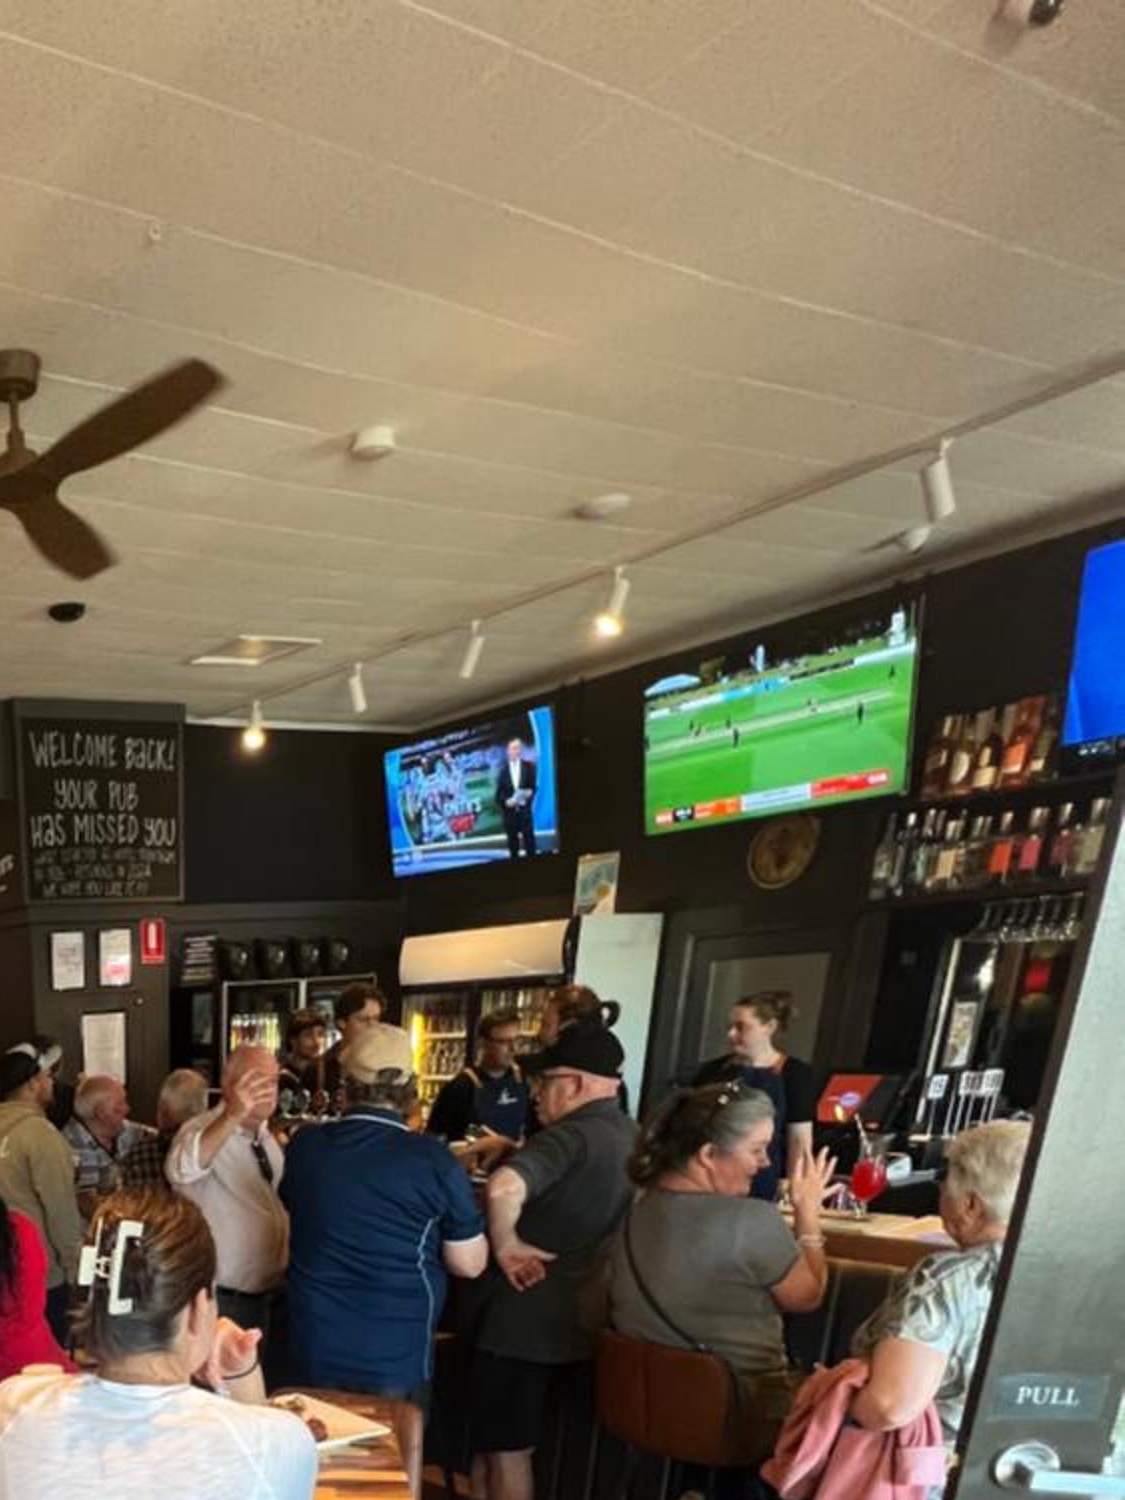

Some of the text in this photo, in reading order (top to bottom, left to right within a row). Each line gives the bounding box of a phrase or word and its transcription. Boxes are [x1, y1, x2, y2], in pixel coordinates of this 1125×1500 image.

[29, 730, 118, 768] WELCOME
[53, 778, 140, 811] YOUR PUB
[73, 814, 139, 844] MISSED
[143, 817, 176, 848] YOU
[1015, 1385, 1080, 1406] PULL
